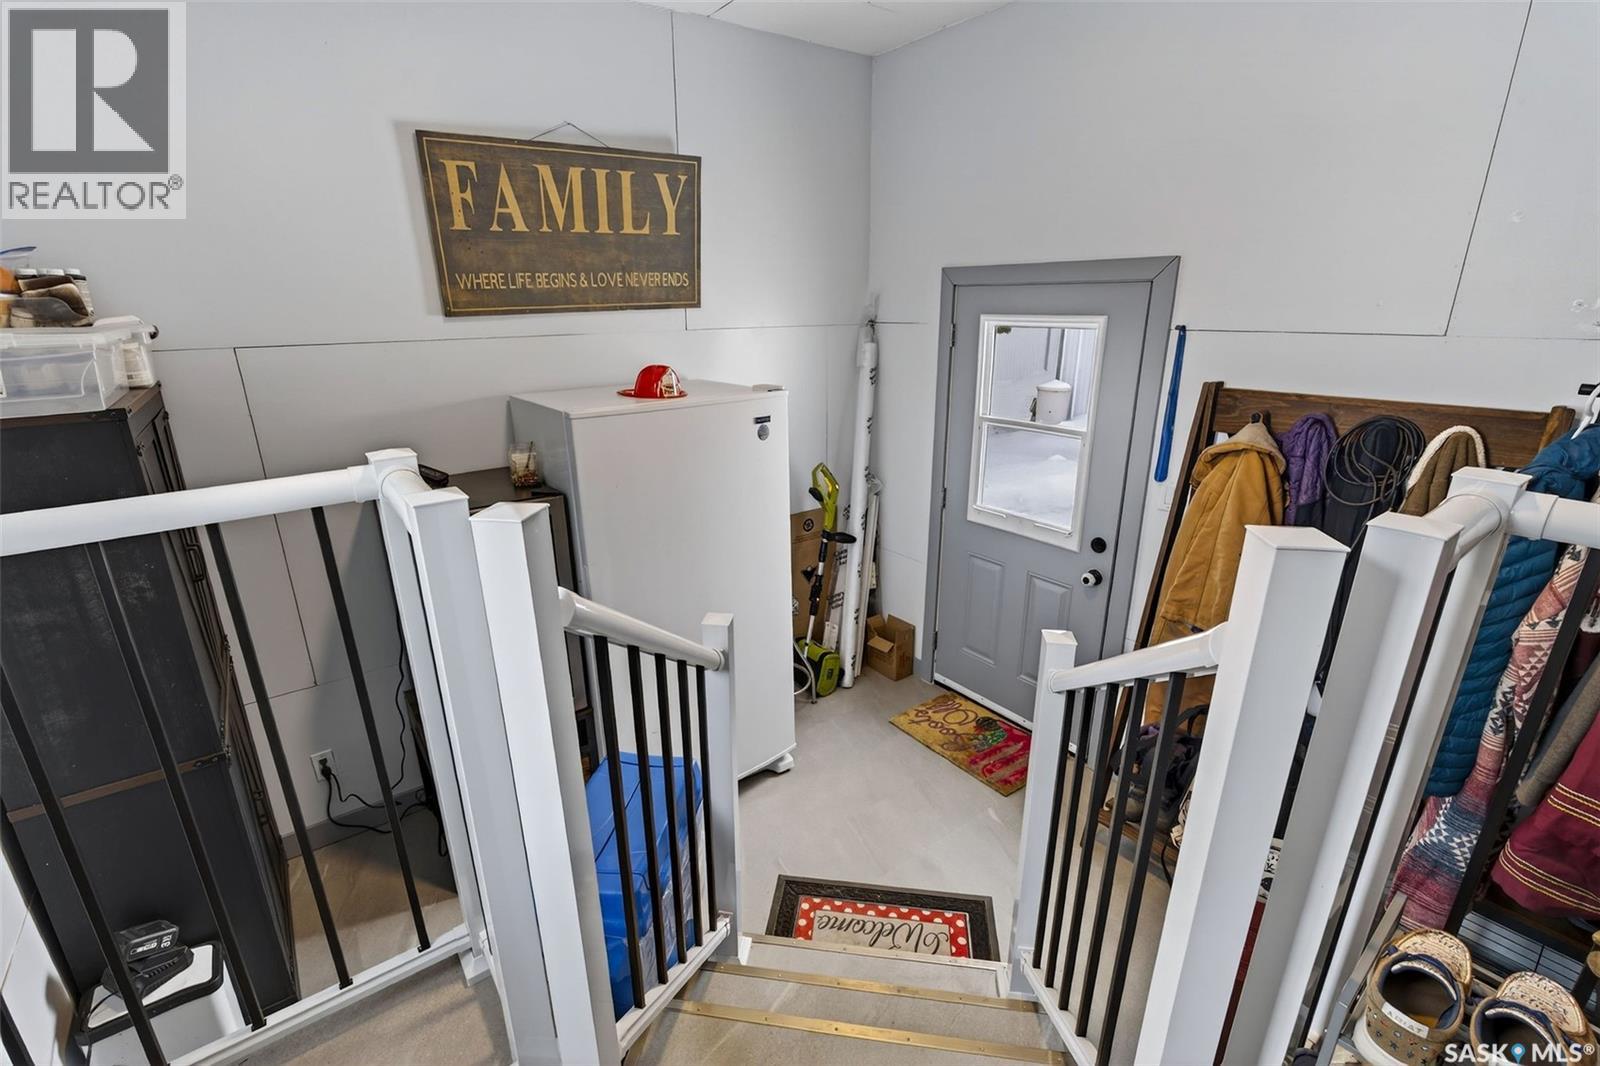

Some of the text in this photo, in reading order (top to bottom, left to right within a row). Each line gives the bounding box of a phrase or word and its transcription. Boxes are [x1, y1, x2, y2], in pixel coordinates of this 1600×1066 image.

[440, 159, 688, 235] FAMILY
[455, 272, 689, 289] WHERE LIFE BEGINS & LOVE NEVER ENDS
[816, 914, 949, 955] Welcome
